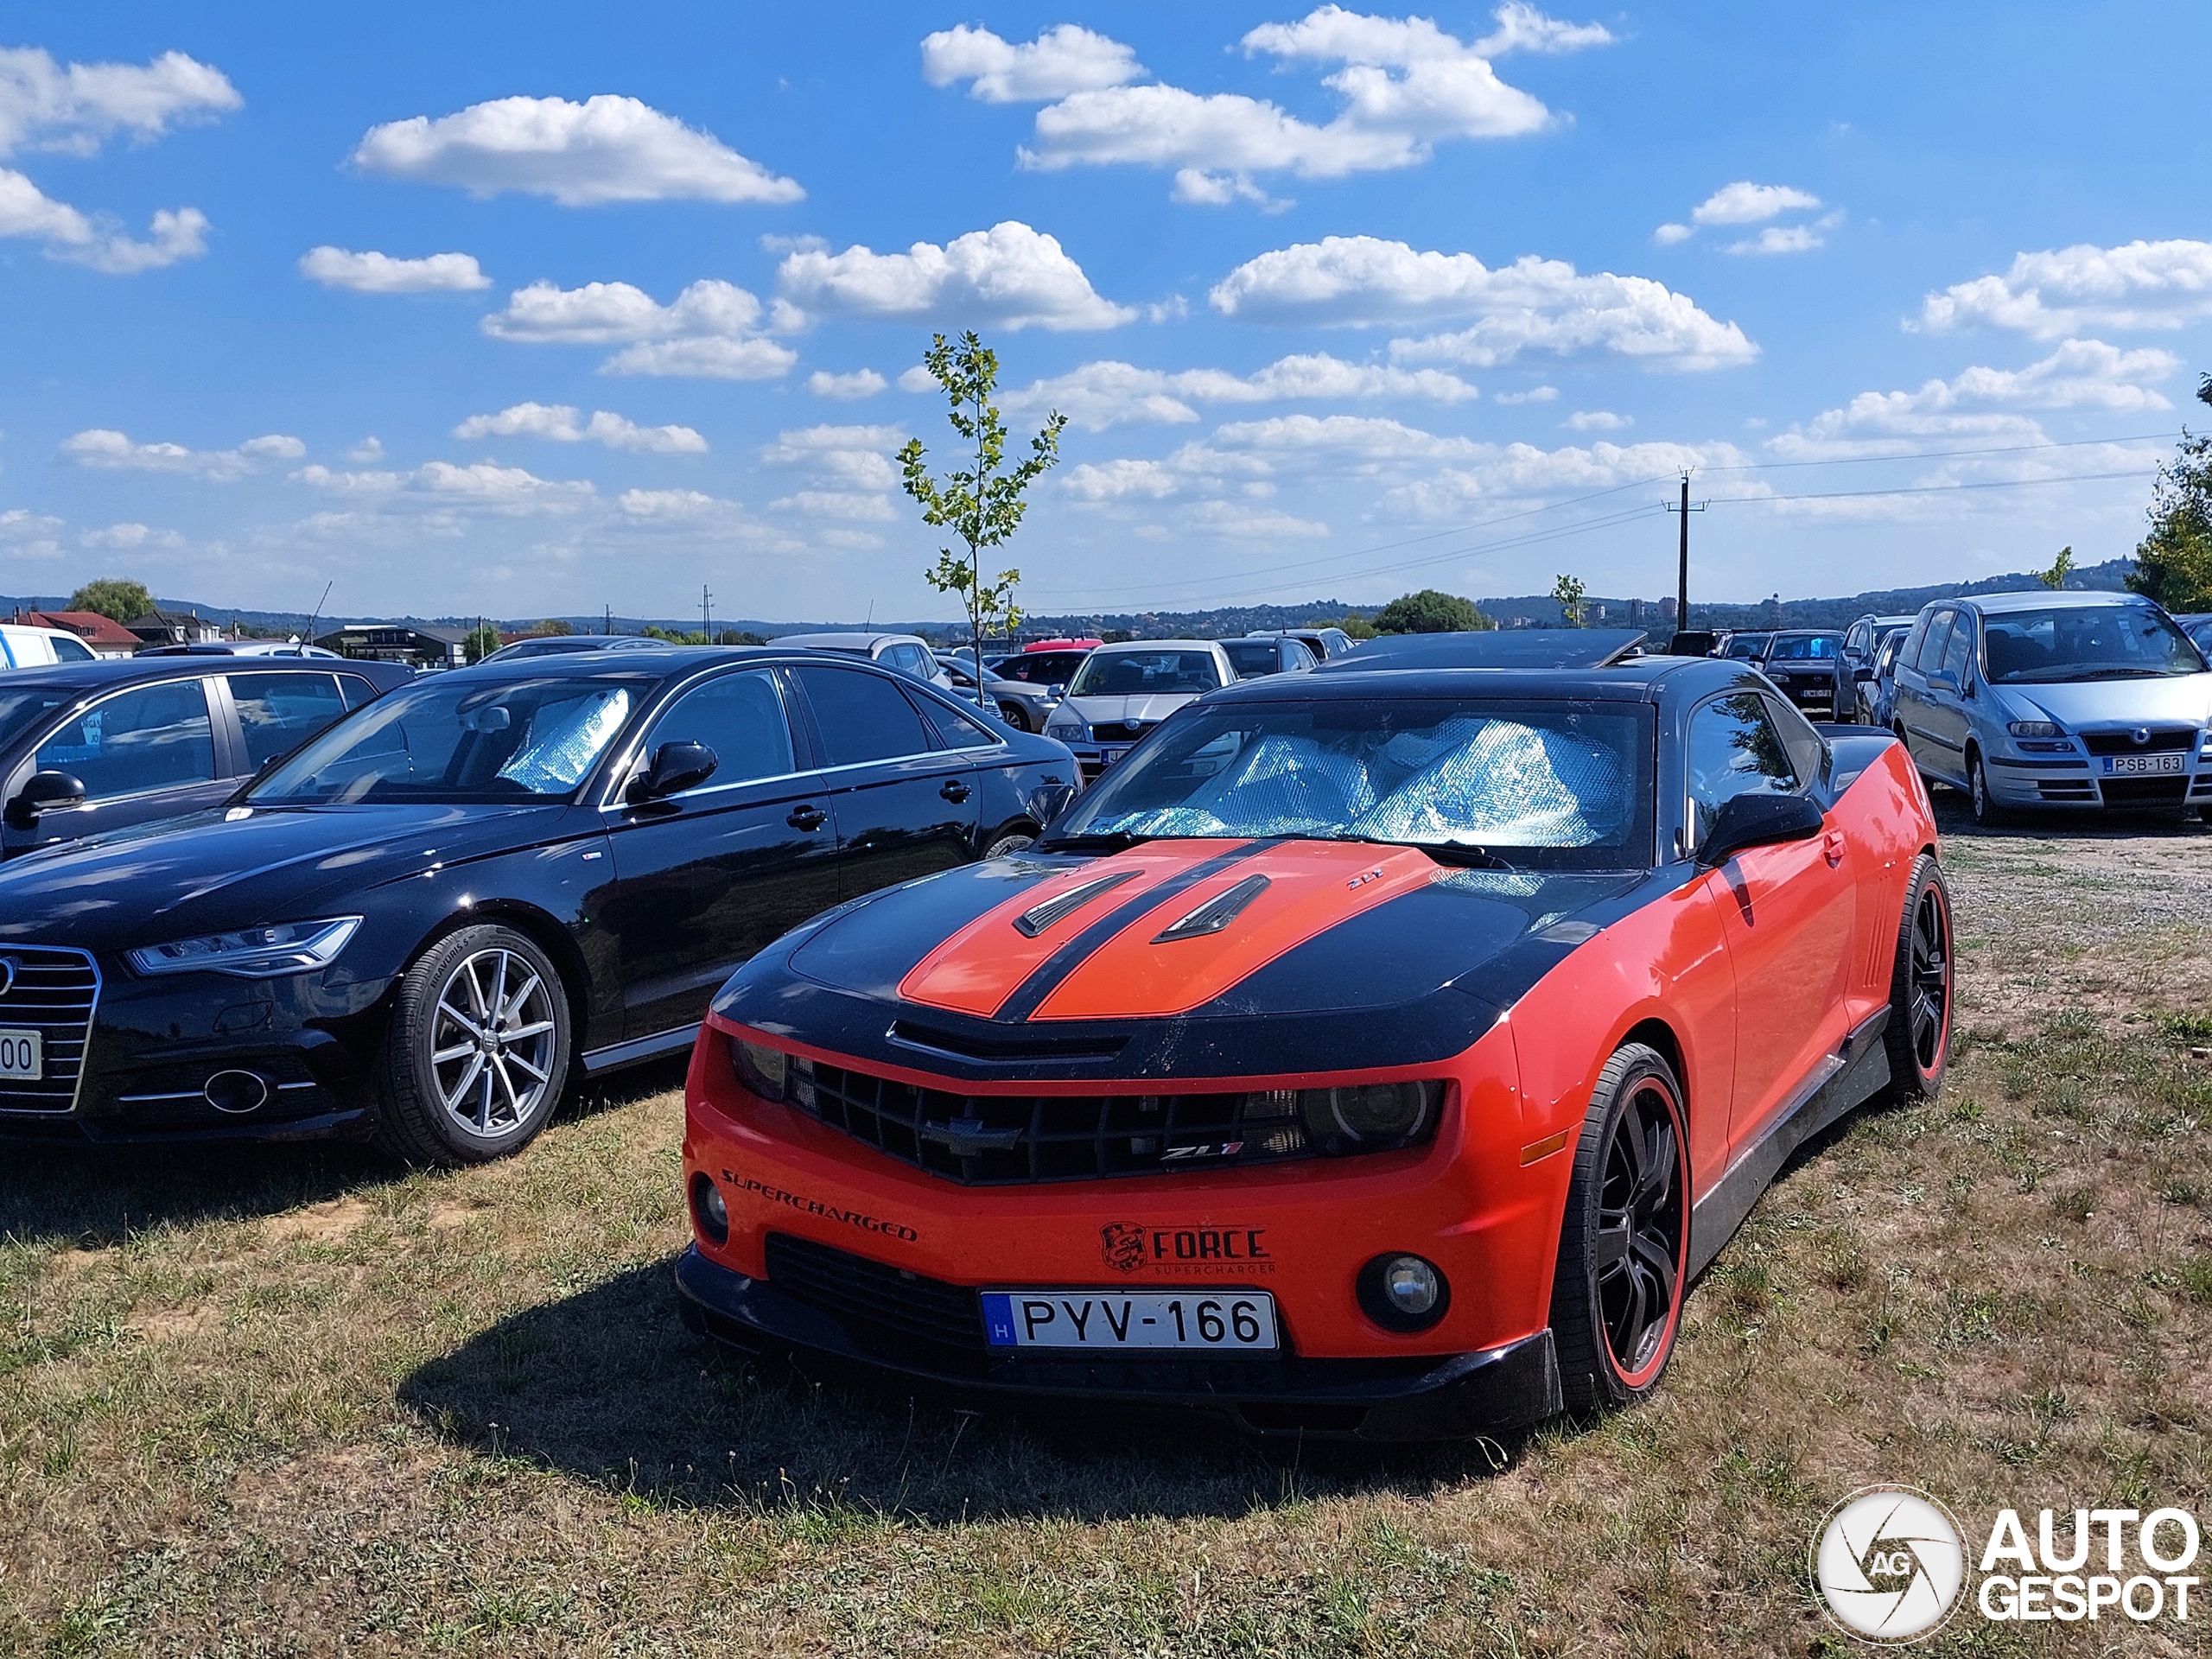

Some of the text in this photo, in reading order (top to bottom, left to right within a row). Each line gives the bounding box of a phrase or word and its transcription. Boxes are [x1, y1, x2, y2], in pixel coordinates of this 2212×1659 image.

[2115, 757, 2180, 772] PSB-163
[430, 943, 463, 988] BRAVURIS
[1160, 1141, 1244, 1160] ZL1
[721, 1168, 918, 1242] SUPERCHARGED
[1153, 1229, 1270, 1259] FORCE
[1154, 1263, 1276, 1275] SUPERCHARGER
[995, 1300, 1262, 1343] H PYV-166
